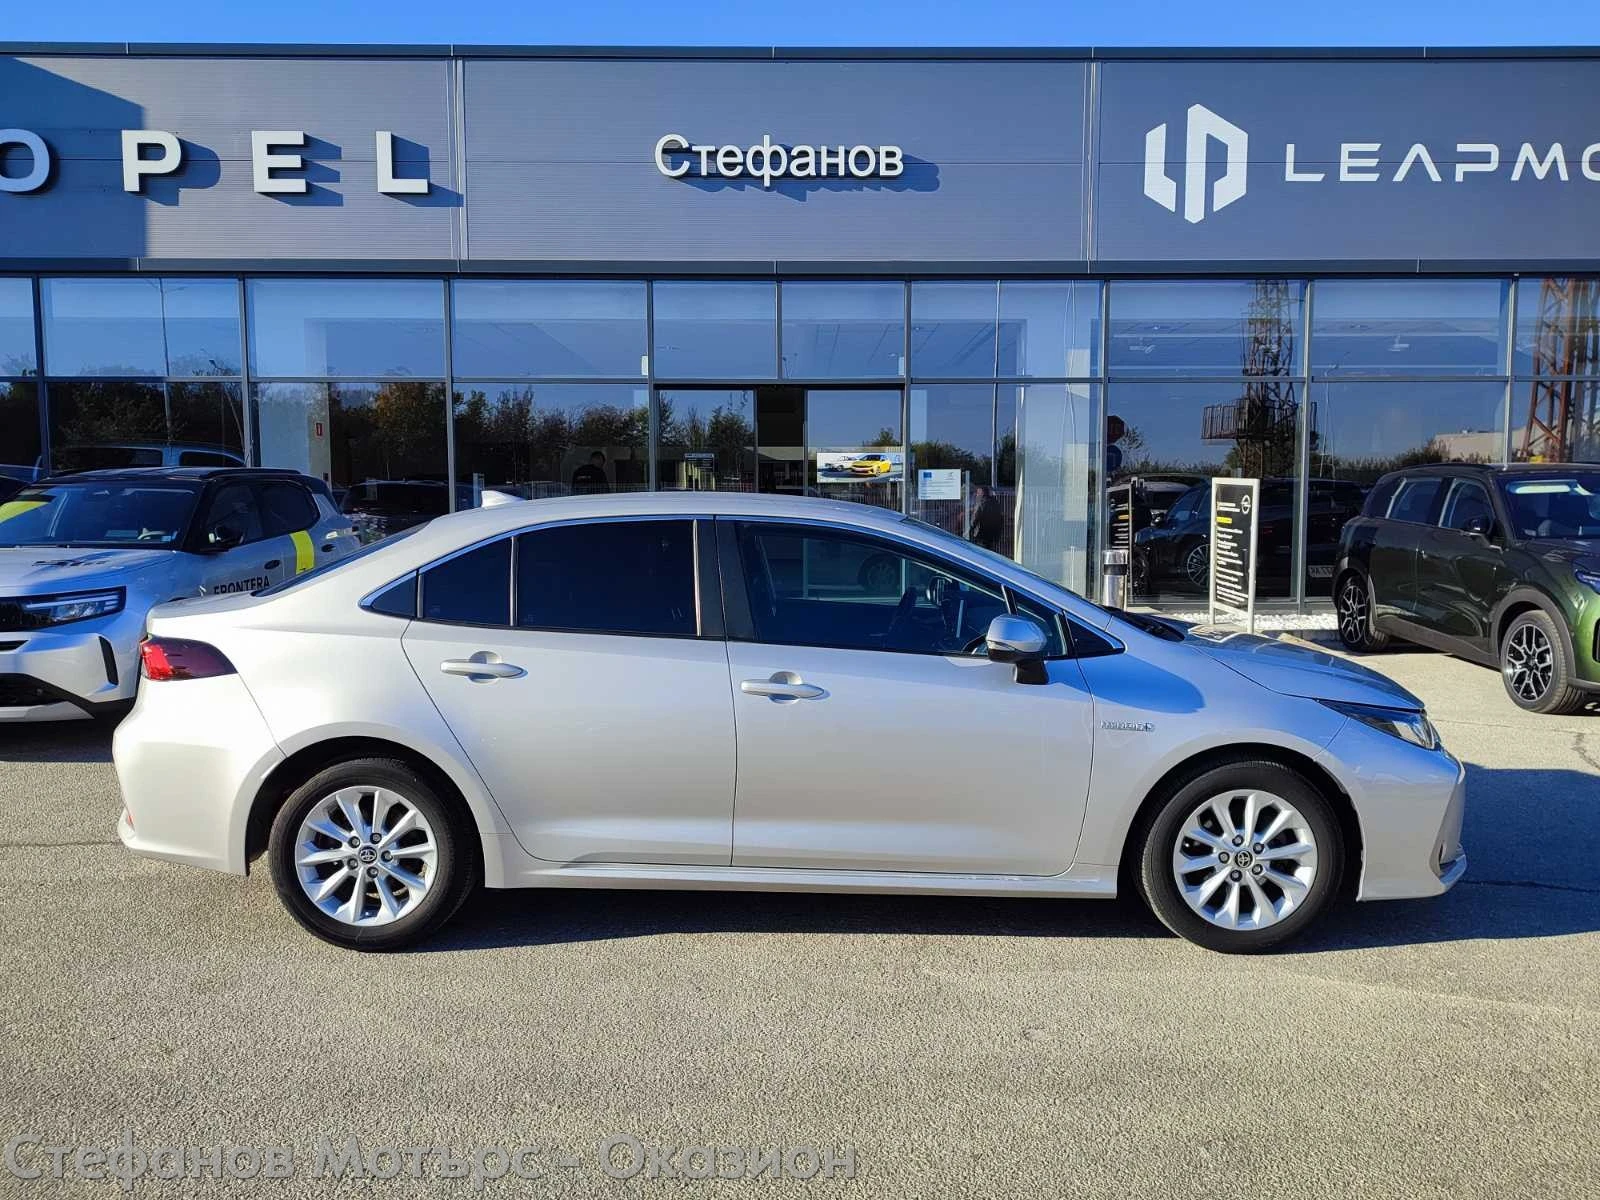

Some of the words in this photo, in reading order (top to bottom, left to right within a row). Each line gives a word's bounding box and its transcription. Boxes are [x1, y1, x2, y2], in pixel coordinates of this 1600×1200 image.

[0, 129, 428, 193] OPEL
[655, 134, 904, 187] Стефанов
[213, 575, 270, 595] FRONTERA
